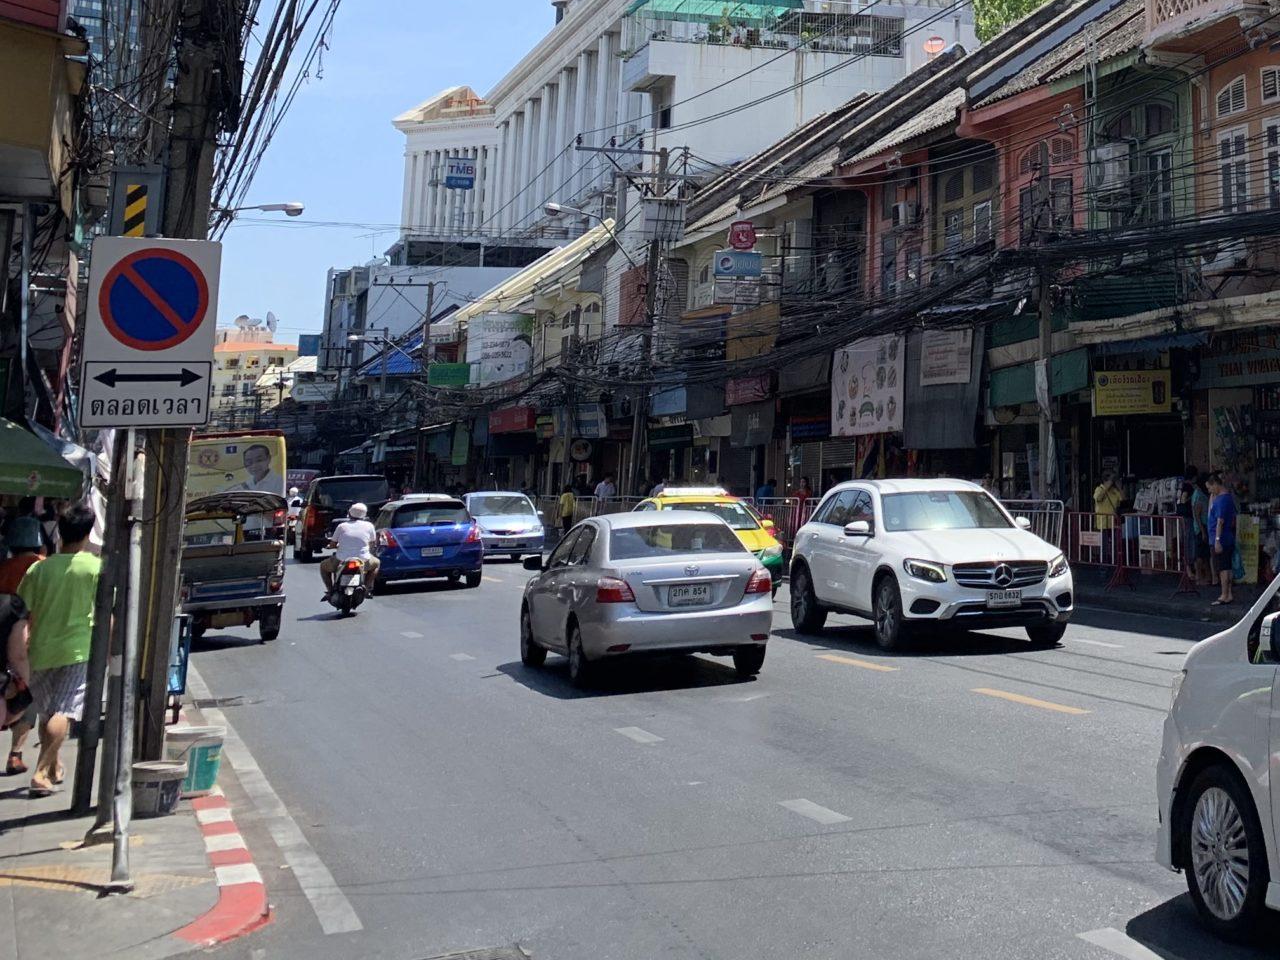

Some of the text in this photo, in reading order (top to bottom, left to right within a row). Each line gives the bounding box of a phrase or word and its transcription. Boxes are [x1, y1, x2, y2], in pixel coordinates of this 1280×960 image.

[448, 162, 474, 175] TMB
[91, 397, 201, 416] ตลอดเวลา
